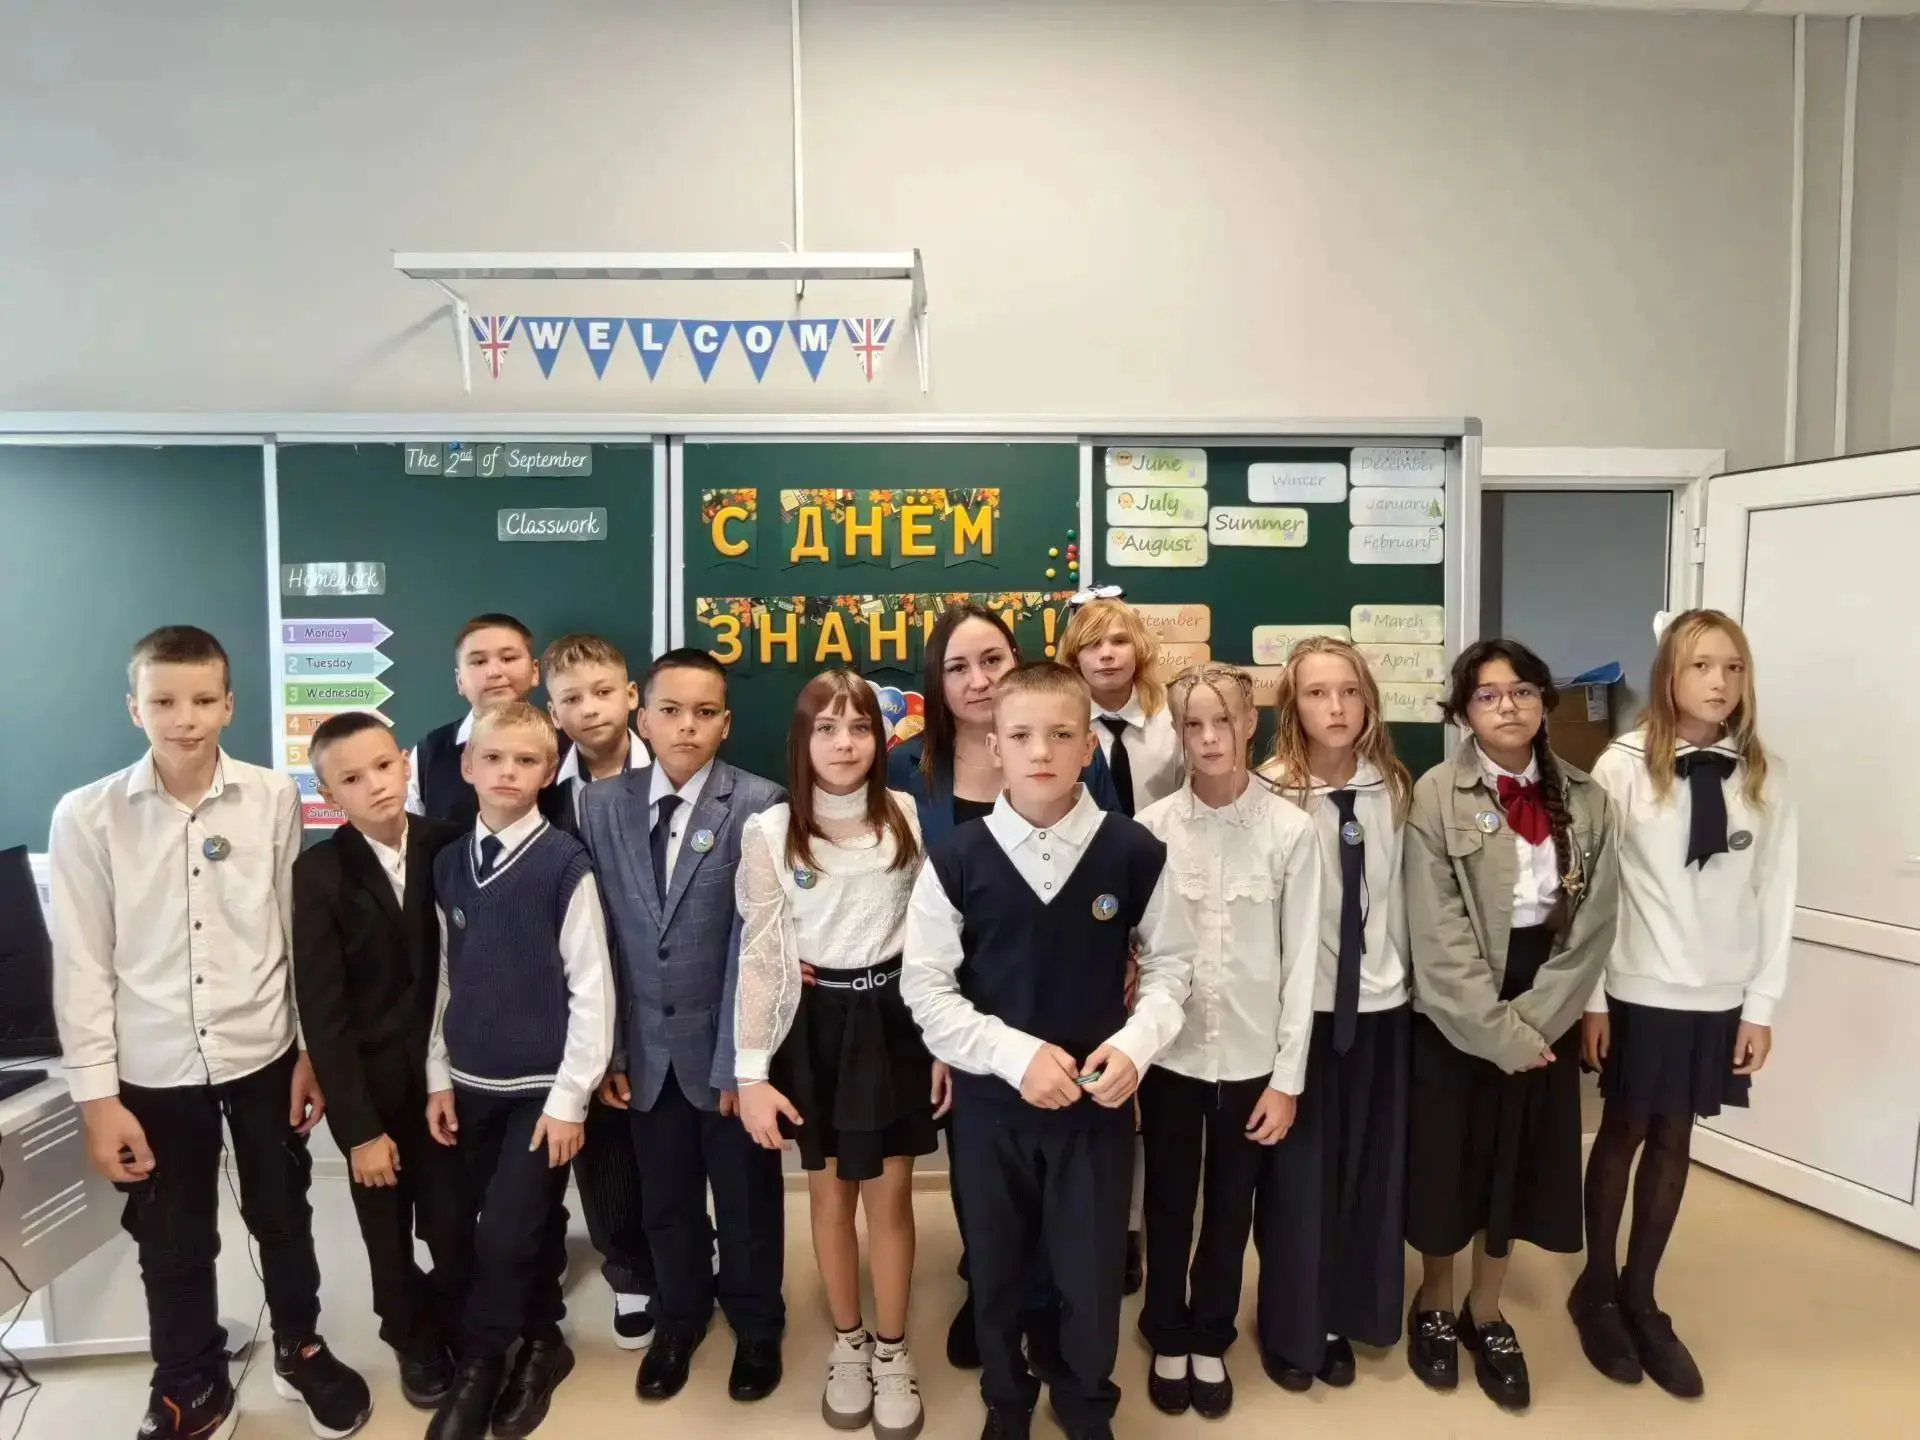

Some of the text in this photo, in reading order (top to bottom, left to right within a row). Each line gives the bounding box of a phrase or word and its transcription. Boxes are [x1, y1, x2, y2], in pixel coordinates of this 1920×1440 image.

[528, 321, 829, 353] WELCOM
[407, 448, 440, 468] The
[482, 446, 502, 476] of
[508, 449, 588, 472] September
[1132, 454, 1183, 472] June
[1361, 454, 1434, 472] December
[1272, 474, 1327, 487] Winter
[1135, 494, 1180, 516] July
[1366, 497, 1430, 515] January
[506, 512, 600, 535] Classwork
[711, 495, 992, 564] С ДНЁМ
[1215, 514, 1304, 532] Summer
[1121, 535, 1193, 557] August
[1363, 533, 1432, 552] February
[288, 567, 379, 590] Homework
[1374, 613, 1425, 628] March
[287, 626, 348, 642] 1 Monday
[287, 656, 353, 674] 2 Tuesday
[1158, 650, 1193, 666] ober
[1380, 652, 1420, 669] April
[288, 686, 372, 703] 3 Wednesday
[1383, 691, 1416, 708] May
[288, 715, 301, 732] 4
[288, 745, 301, 762] 5
[852, 969, 887, 990] alo
